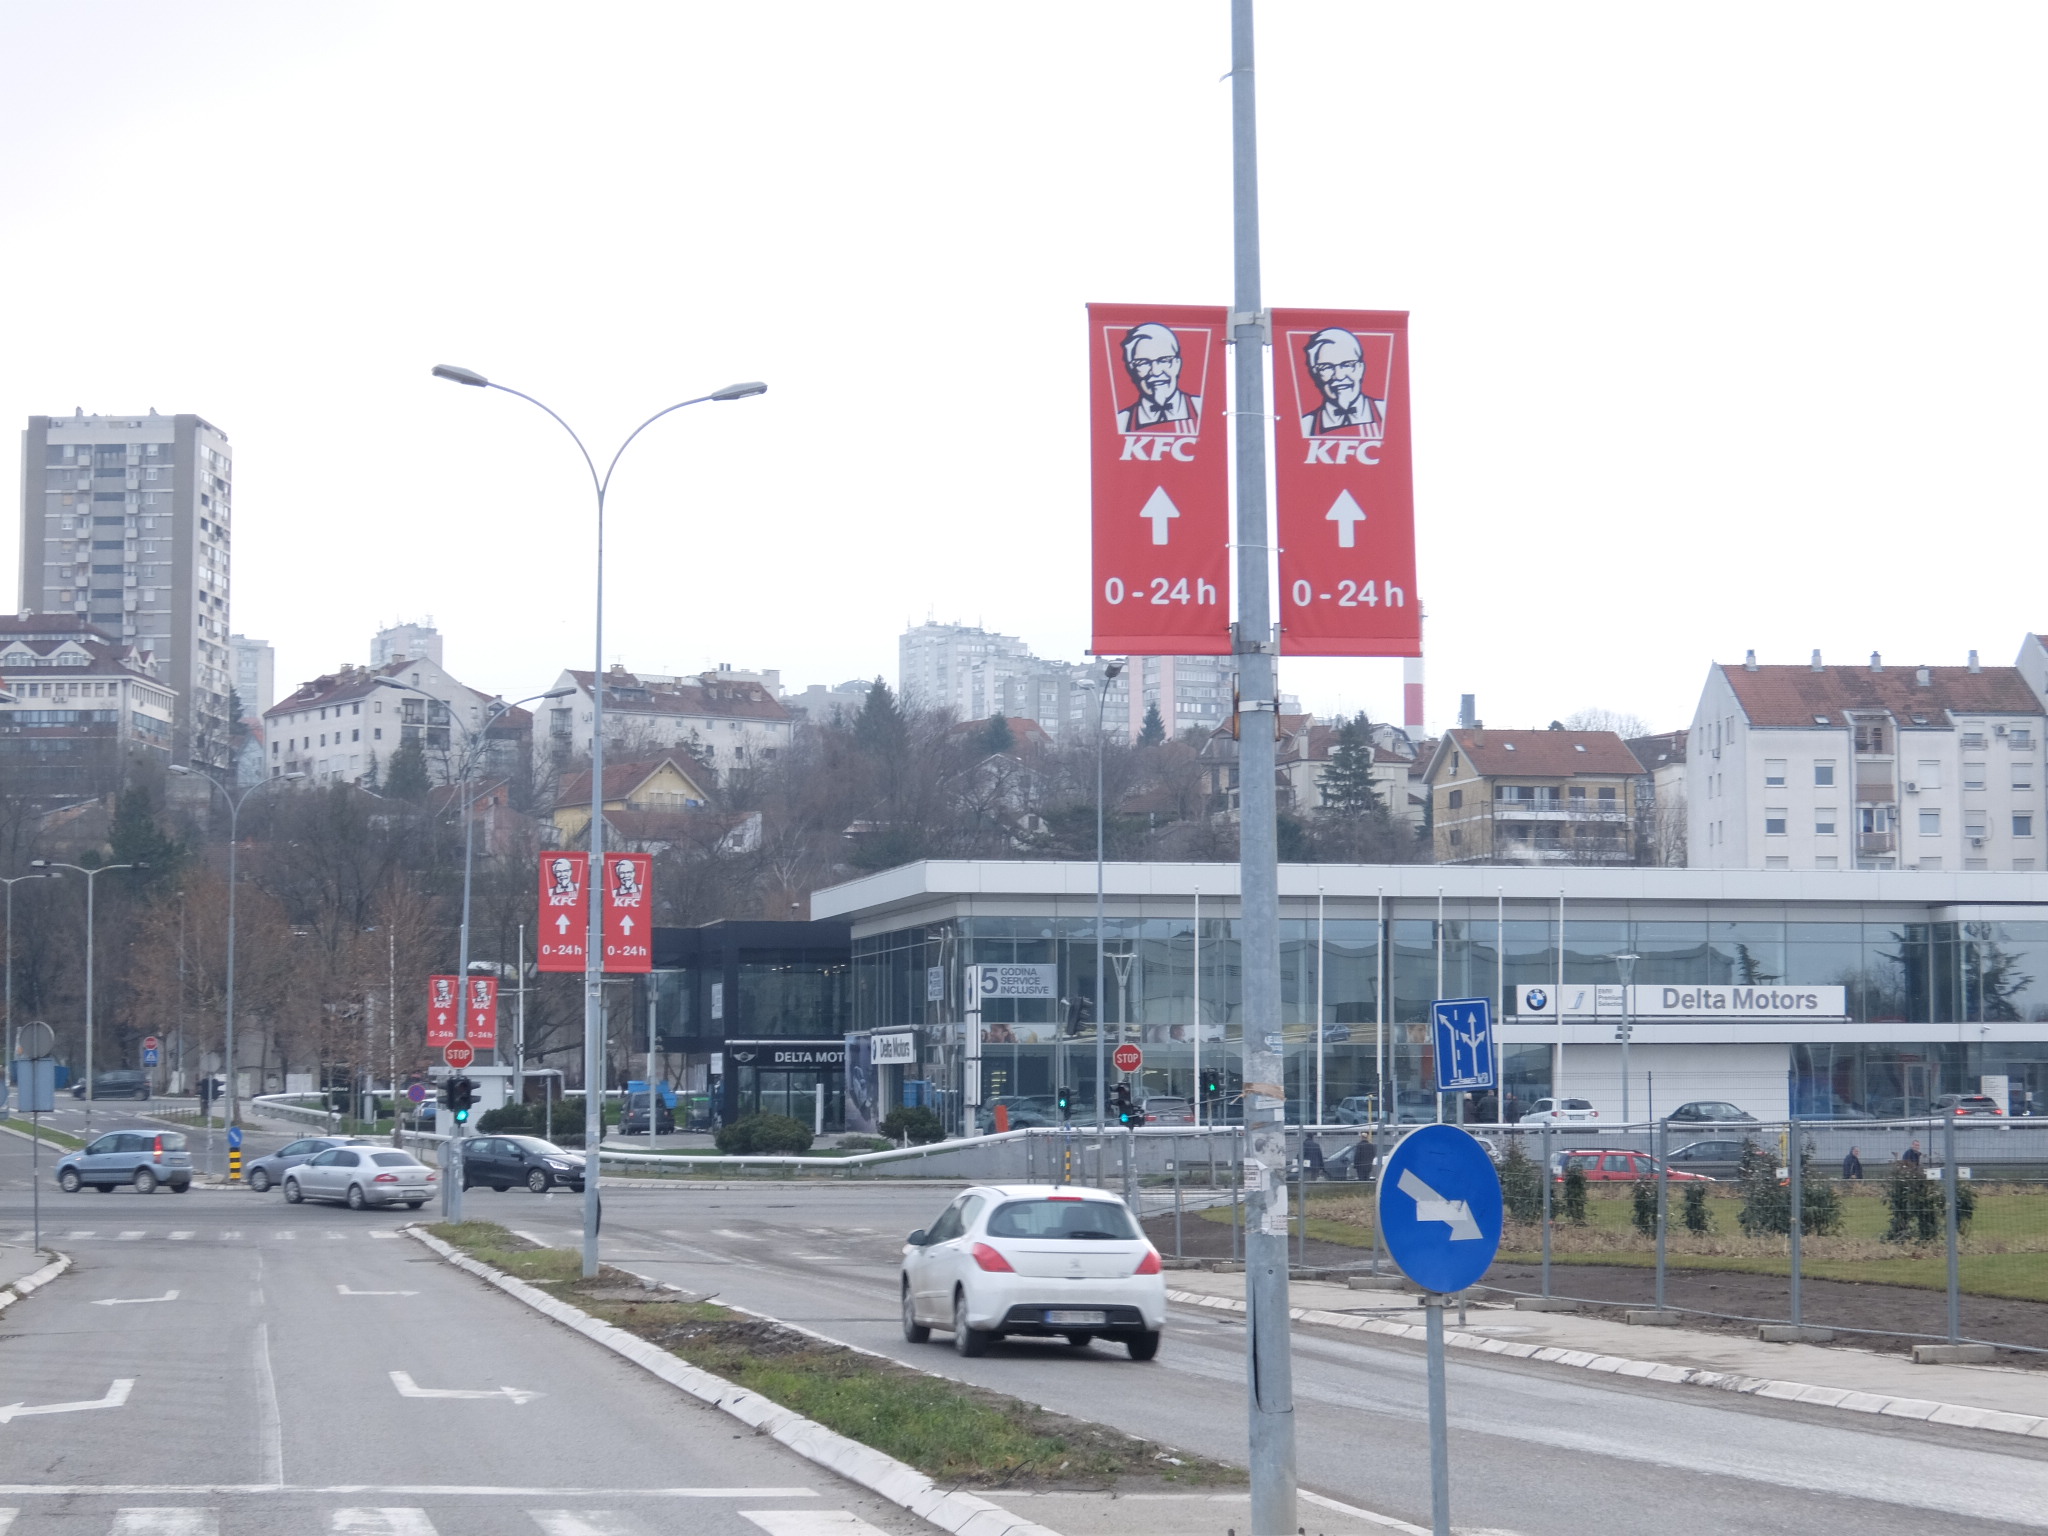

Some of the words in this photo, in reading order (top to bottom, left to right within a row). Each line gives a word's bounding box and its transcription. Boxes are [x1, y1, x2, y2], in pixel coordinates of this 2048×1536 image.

[1119, 436, 1197, 462] KFC
[1304, 439, 1383, 466] KFC
[549, 897, 577, 907] KFC
[613, 898, 640, 907] KFC
[1000, 968, 1037, 976] GODINA
[981, 967, 999, 994] 5
[1000, 977, 1040, 985] SERVICE
[1000, 986, 1049, 994] INCLUSIVE
[1663, 988, 1726, 1009] Delta
[1733, 988, 1818, 1009] Motors
[447, 1049, 470, 1060] STOP
[775, 1051, 812, 1062] DELTA
[815, 1051, 845, 1062] MOT
[1116, 1053, 1139, 1064] STOP
